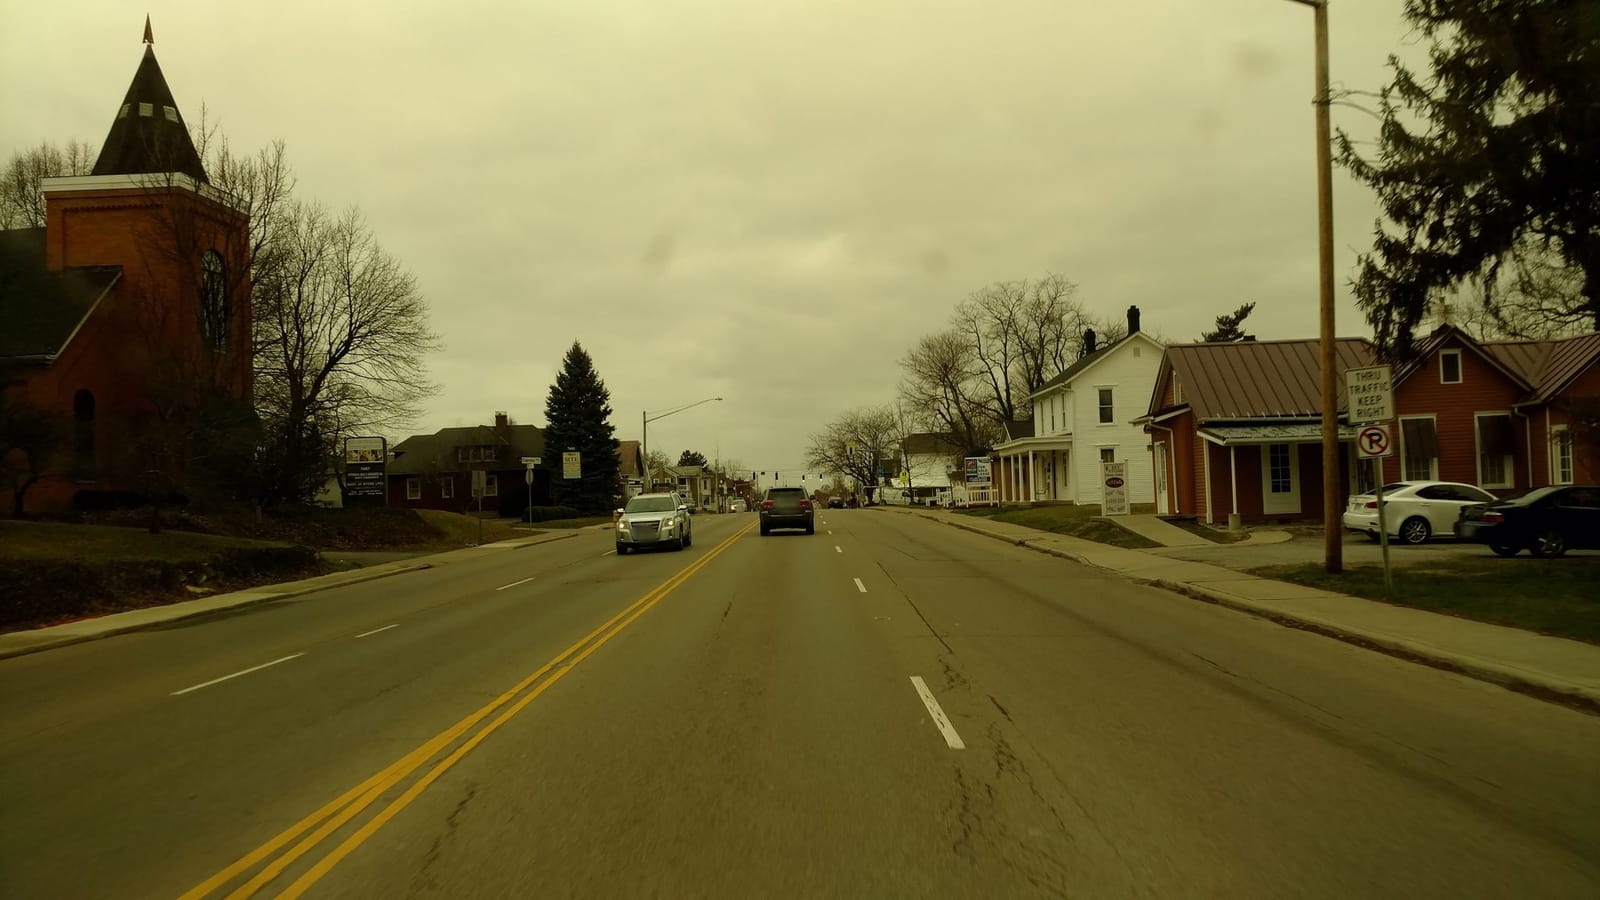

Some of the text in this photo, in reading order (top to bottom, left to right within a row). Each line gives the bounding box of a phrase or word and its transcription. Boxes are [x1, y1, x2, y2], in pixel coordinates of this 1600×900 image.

[1355, 370, 1381, 382] THRU
[1350, 381, 1390, 394] TRAFFIC
[1358, 394, 1382, 406] KEEP
[1356, 406, 1384, 418] RIGHT
